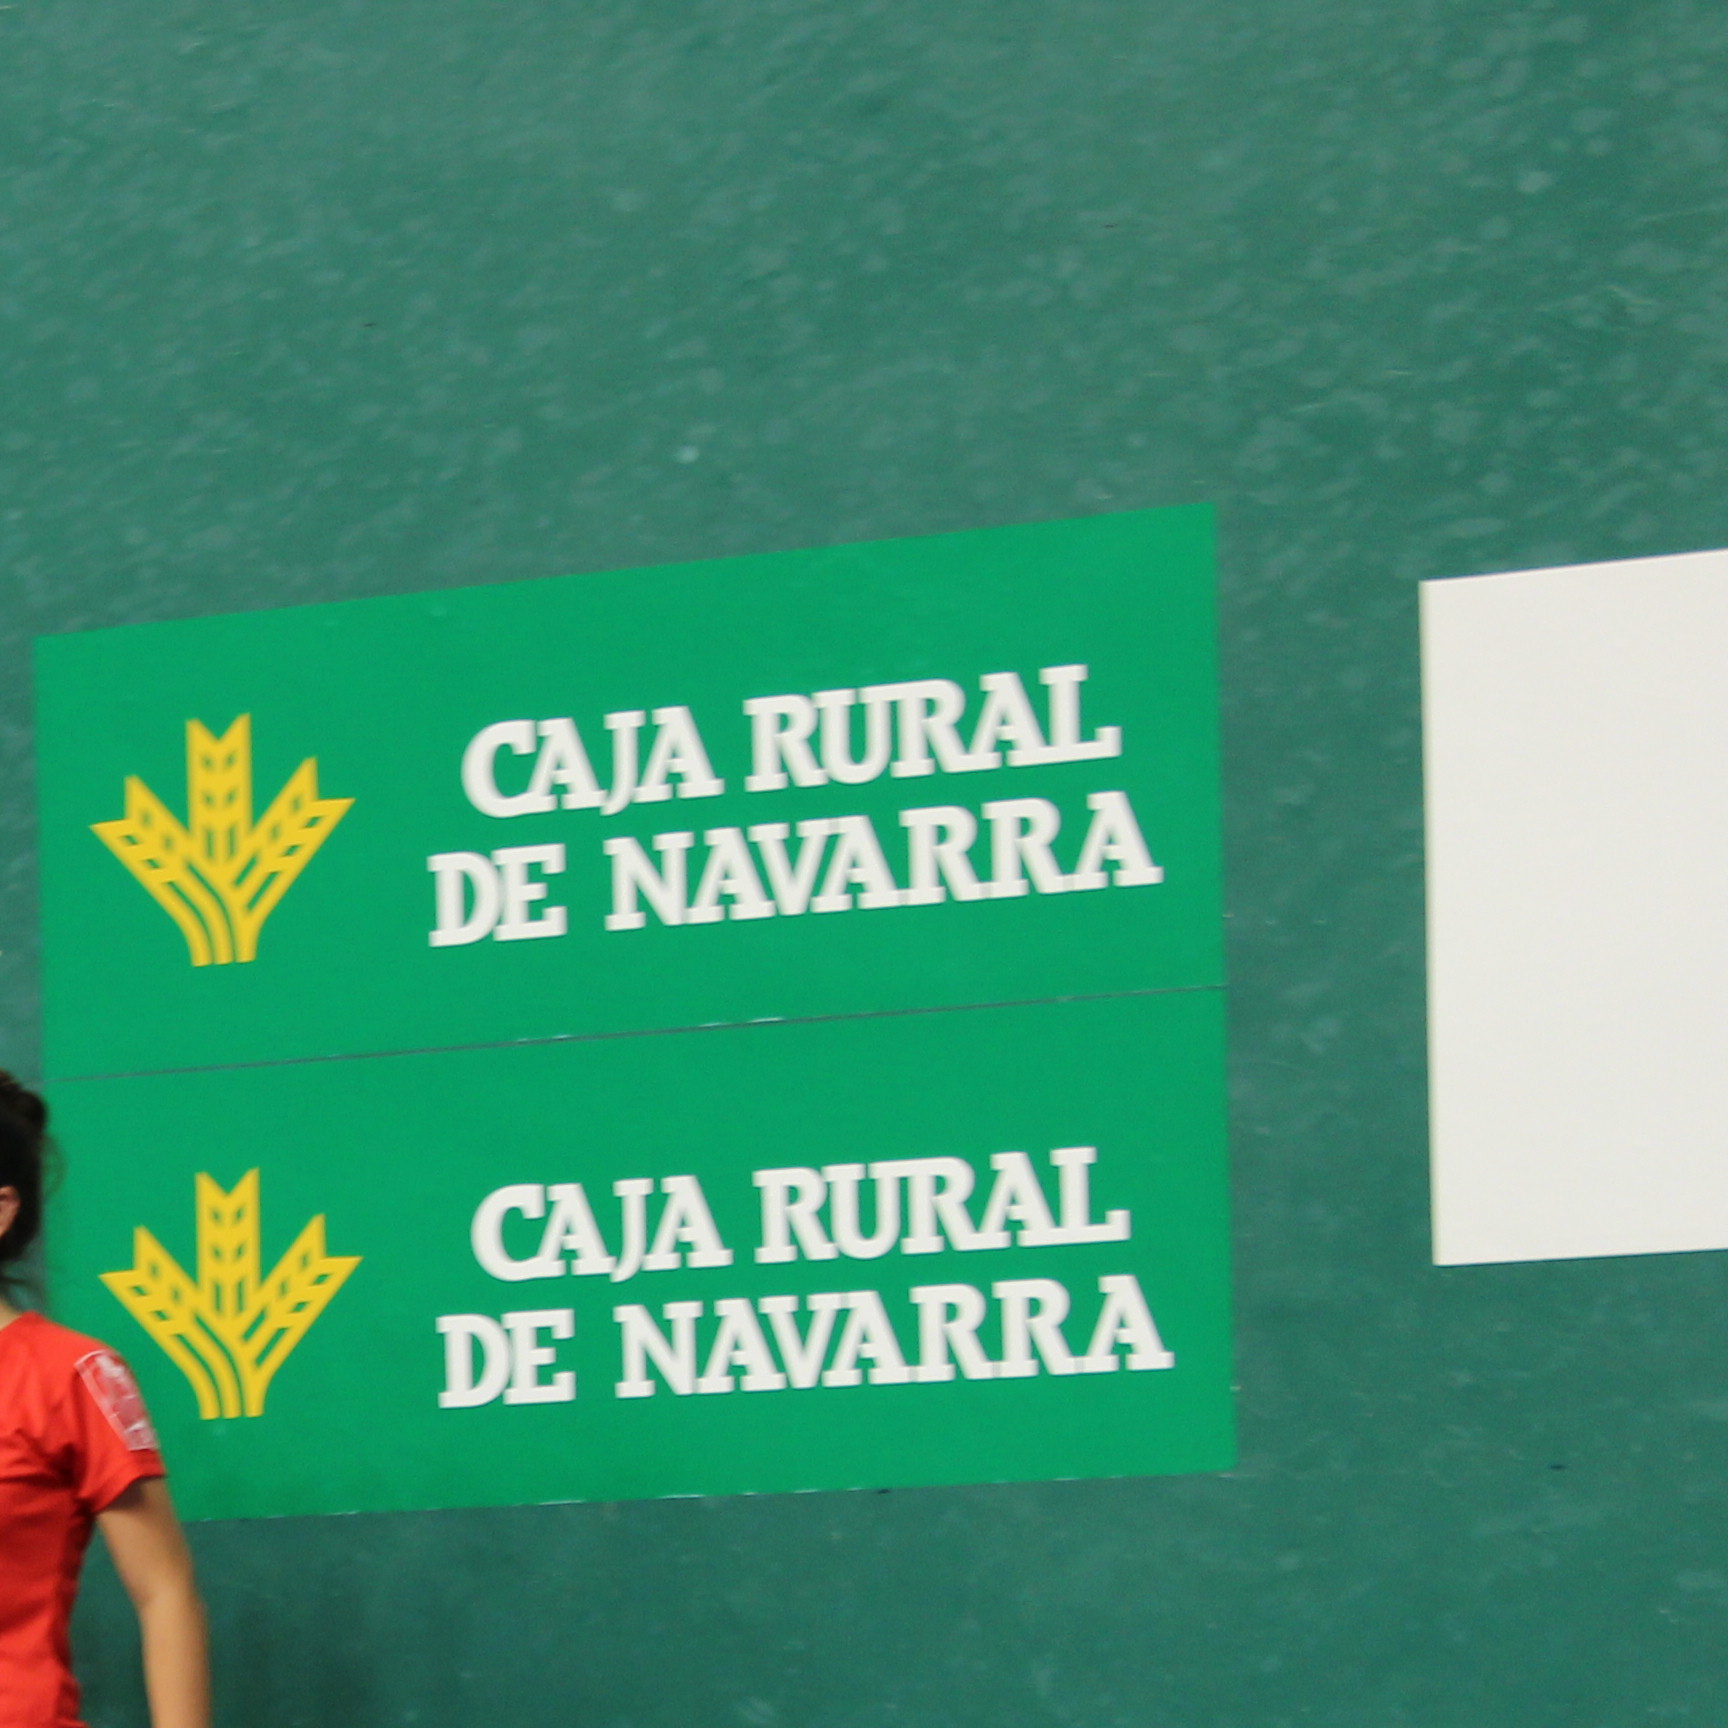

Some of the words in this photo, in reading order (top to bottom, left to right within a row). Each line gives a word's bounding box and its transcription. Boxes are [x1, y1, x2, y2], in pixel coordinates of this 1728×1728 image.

[461, 704, 726, 819] CAJA
[743, 662, 1123, 793] RURAL
[426, 842, 568, 948] DE
[603, 789, 1165, 932] NAVARRA
[470, 1173, 734, 1284] CAJA
[752, 1145, 1132, 1265] RURAL
[435, 1307, 577, 1409] DE
[613, 1273, 1176, 1399] NAVARRA
